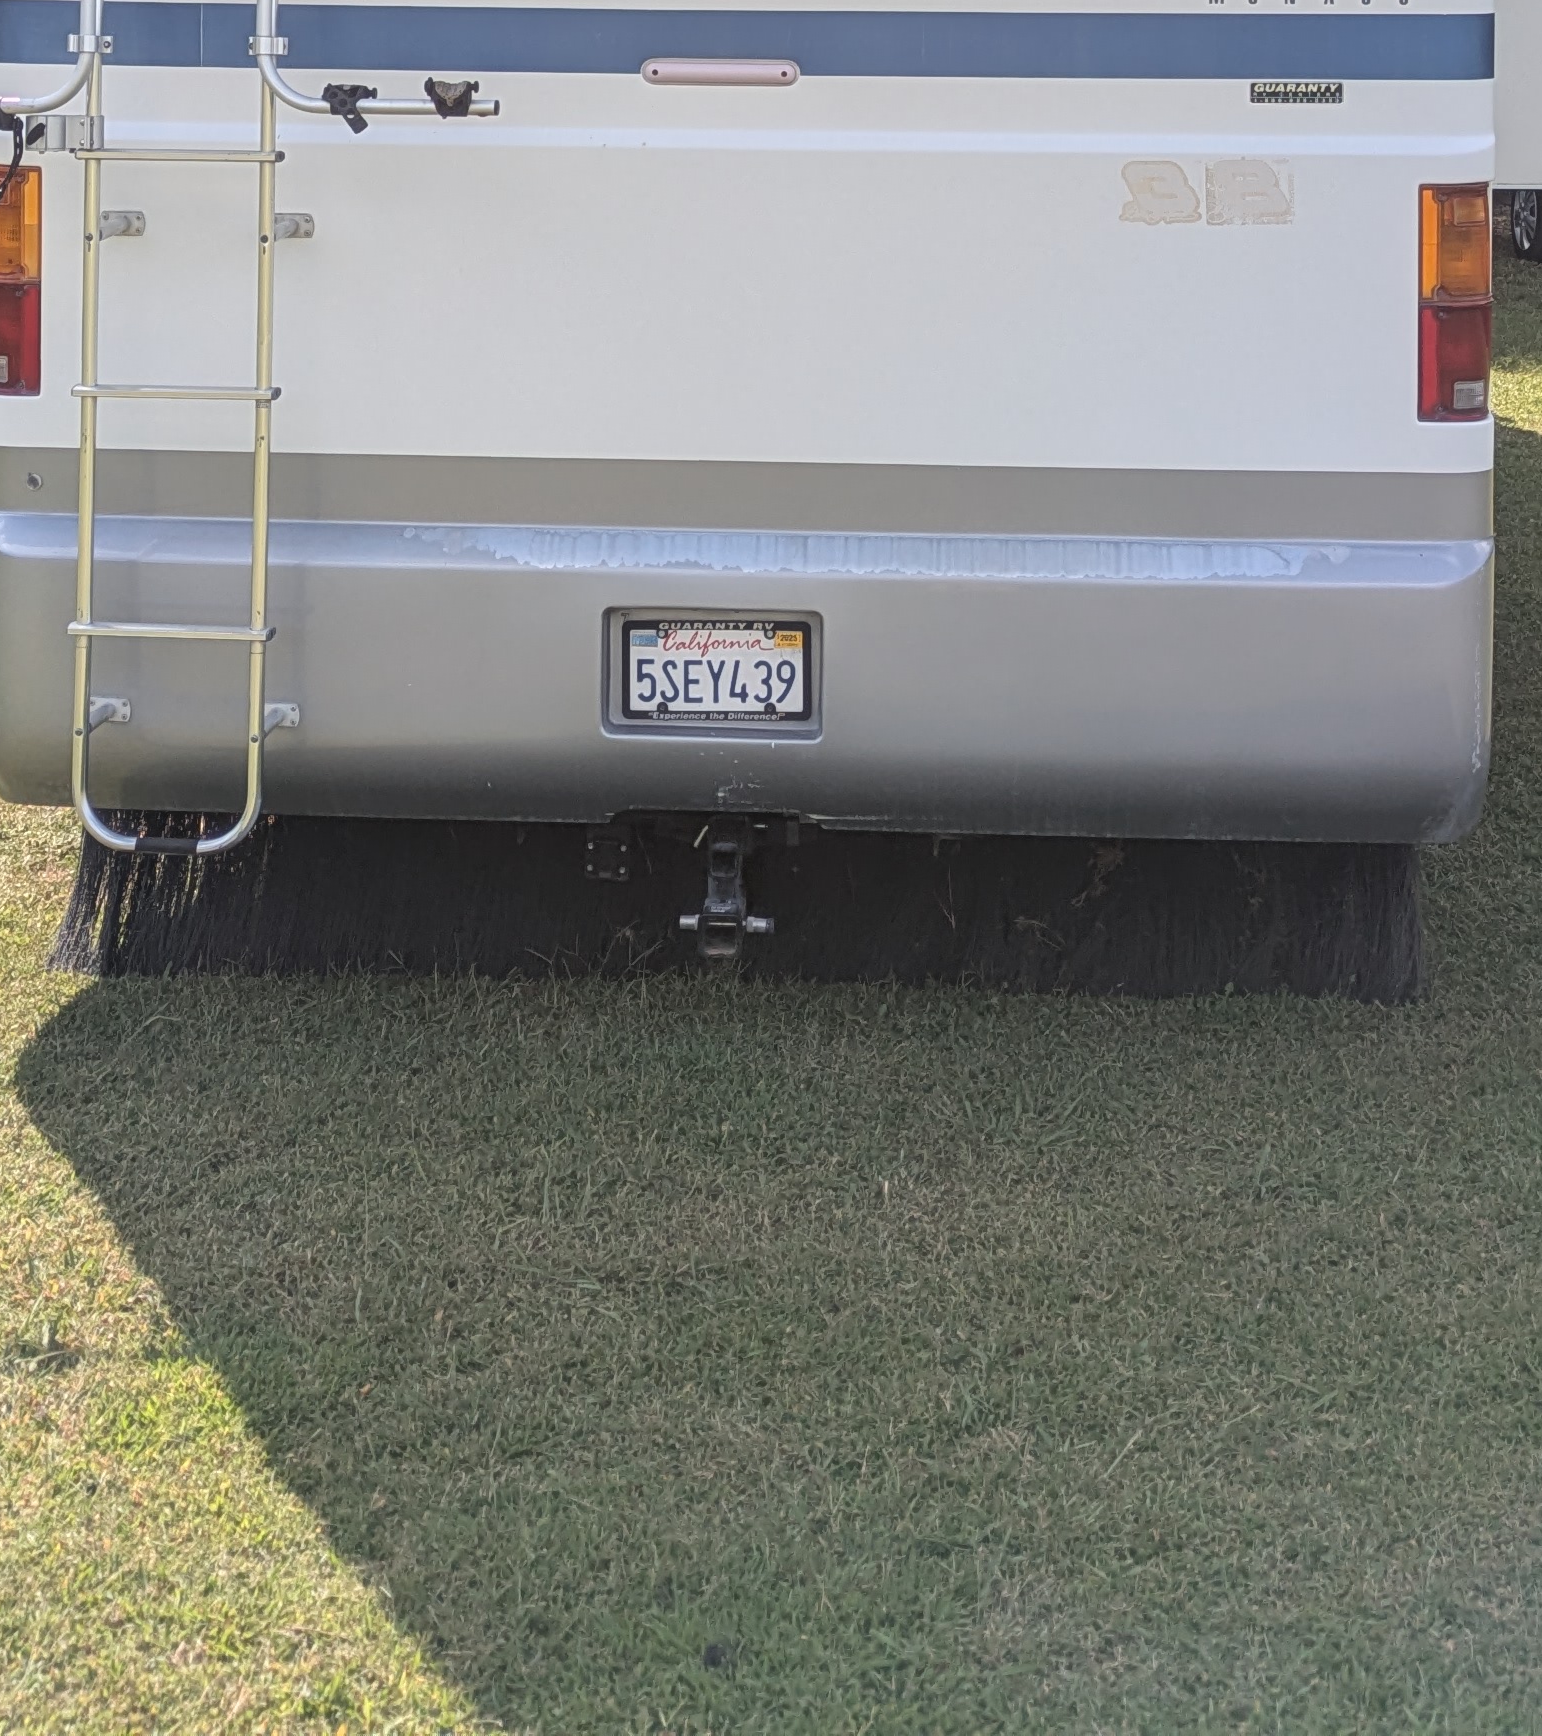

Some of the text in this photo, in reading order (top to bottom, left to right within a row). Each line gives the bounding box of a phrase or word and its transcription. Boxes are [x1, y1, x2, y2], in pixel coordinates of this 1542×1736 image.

[1254, 83, 1339, 92] GUARANTY
[663, 630, 774, 658] California
[637, 659, 796, 703] 5SEY439
[710, 712, 725, 720] the
